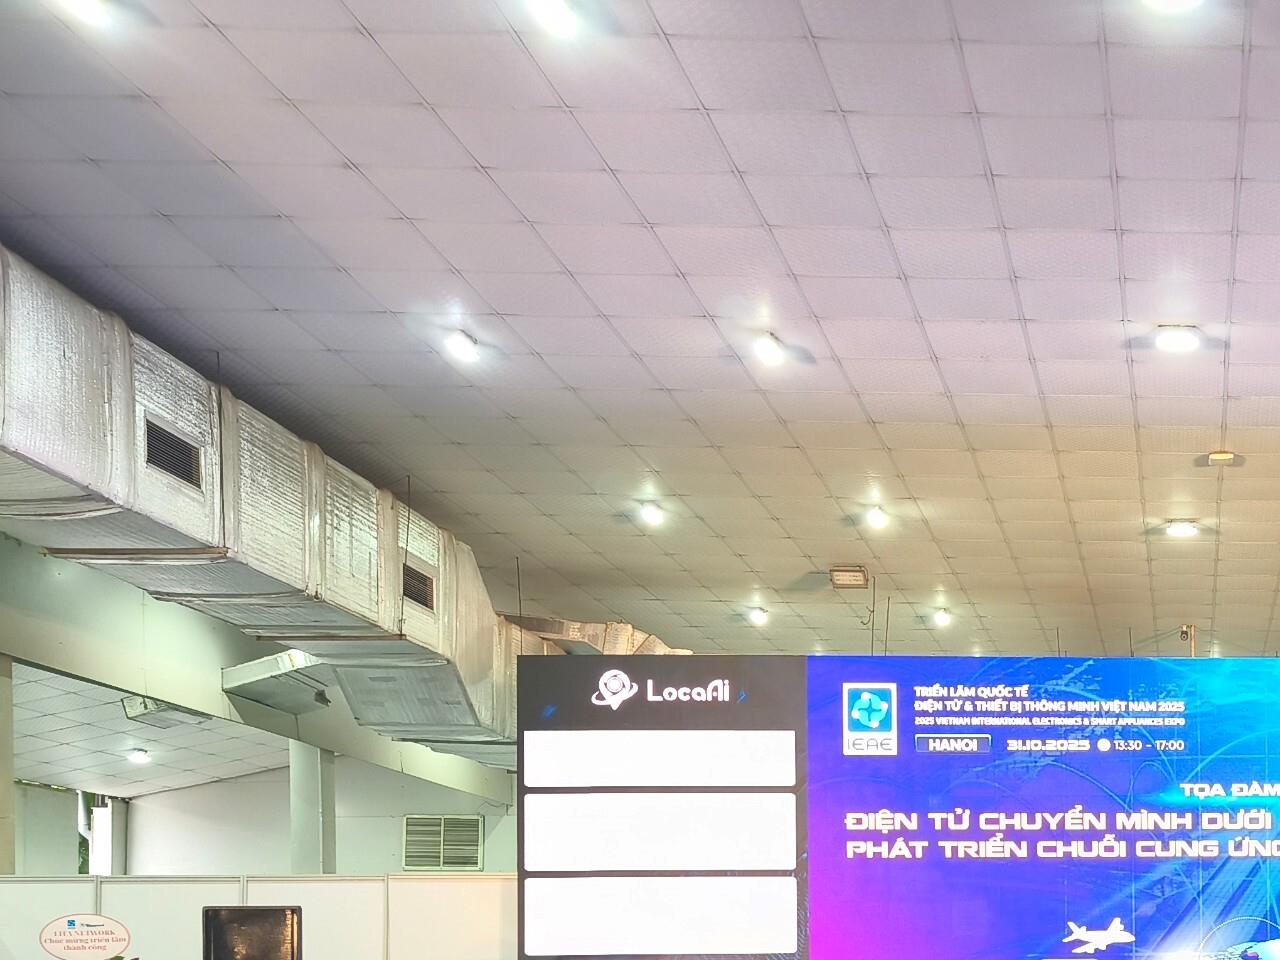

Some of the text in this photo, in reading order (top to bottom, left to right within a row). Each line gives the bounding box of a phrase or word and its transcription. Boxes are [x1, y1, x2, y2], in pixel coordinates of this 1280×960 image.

[647, 679, 730, 701] LocaAi
[977, 684, 1013, 698] QUỐC
[914, 699, 943, 713] ĐIỆN
[963, 701, 973, 711] &
[975, 698, 1008, 711] THIẾT
[1009, 701, 1022, 713] BỊ
[1023, 699, 1066, 711] THÔNG
[1067, 701, 1100, 711] MINH
[1100, 699, 1127, 713] VIỆT
[1128, 701, 1157, 711] NAM
[1158, 701, 1186, 711] 2025
[847, 738, 893, 751] IEAE
[928, 738, 978, 751] HANOI
[1006, 739, 1091, 751] 31.10.2025
[1114, 739, 1142, 751] 13:30
[1155, 739, 1184, 751] 17:00
[1180, 783, 1227, 799] TỌA
[844, 808, 918, 834] ĐIỆN
[928, 807, 970, 830] TỬ
[979, 805, 1106, 830] CHUYỂN
[1116, 809, 1192, 830] MÌNH
[1201, 809, 1271, 830] DƯỚI
[846, 837, 928, 858] PHÁT
[938, 833, 1028, 858] TRIỂN
[1036, 834, 1126, 858] CHUỖI
[1135, 840, 1219, 857] CUNG
